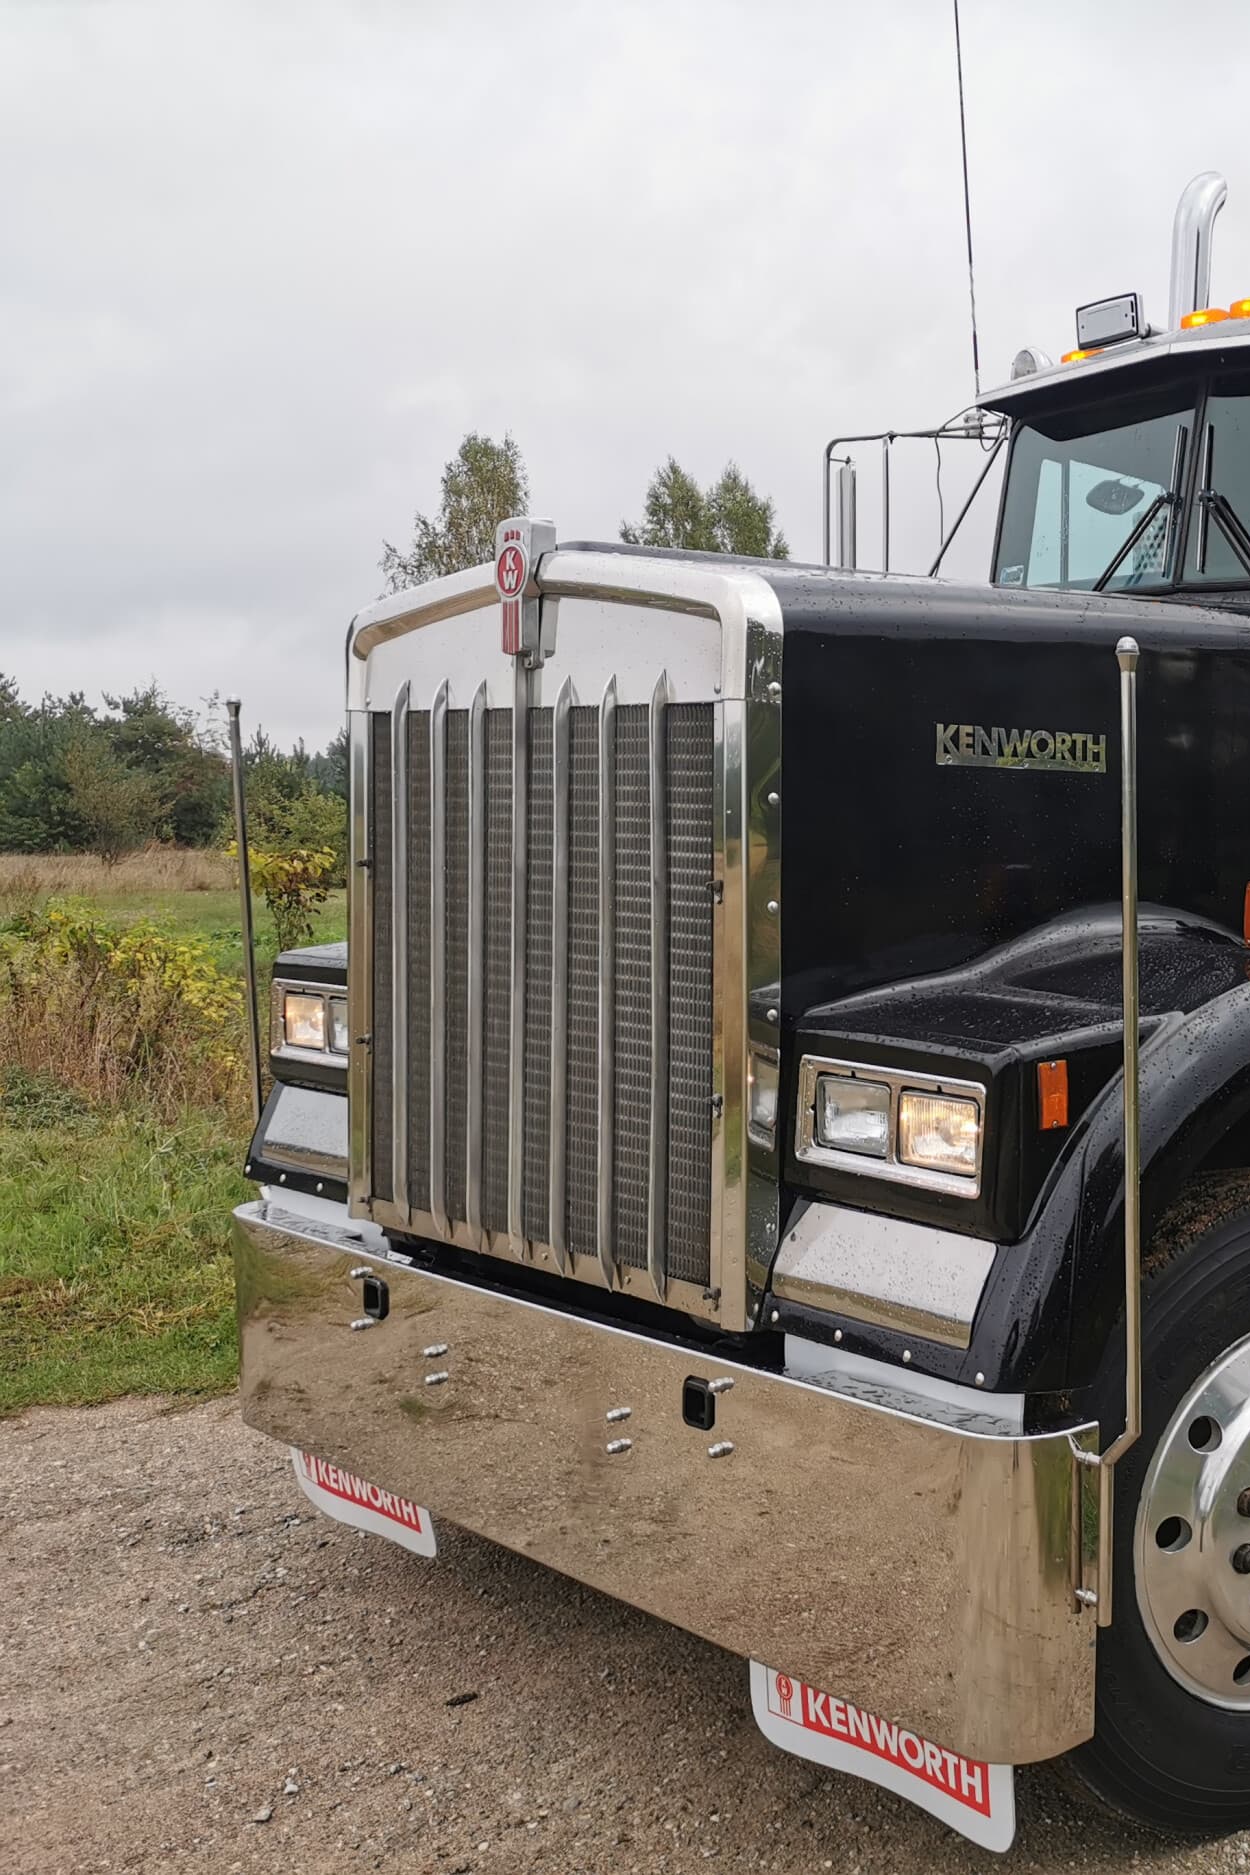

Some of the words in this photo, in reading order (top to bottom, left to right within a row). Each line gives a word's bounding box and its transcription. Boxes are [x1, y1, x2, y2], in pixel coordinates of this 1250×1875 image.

[936, 723, 1106, 764] KENWORTH
[318, 1459, 417, 1525] KENWORTH
[807, 1687, 983, 1804] KENWORTH
